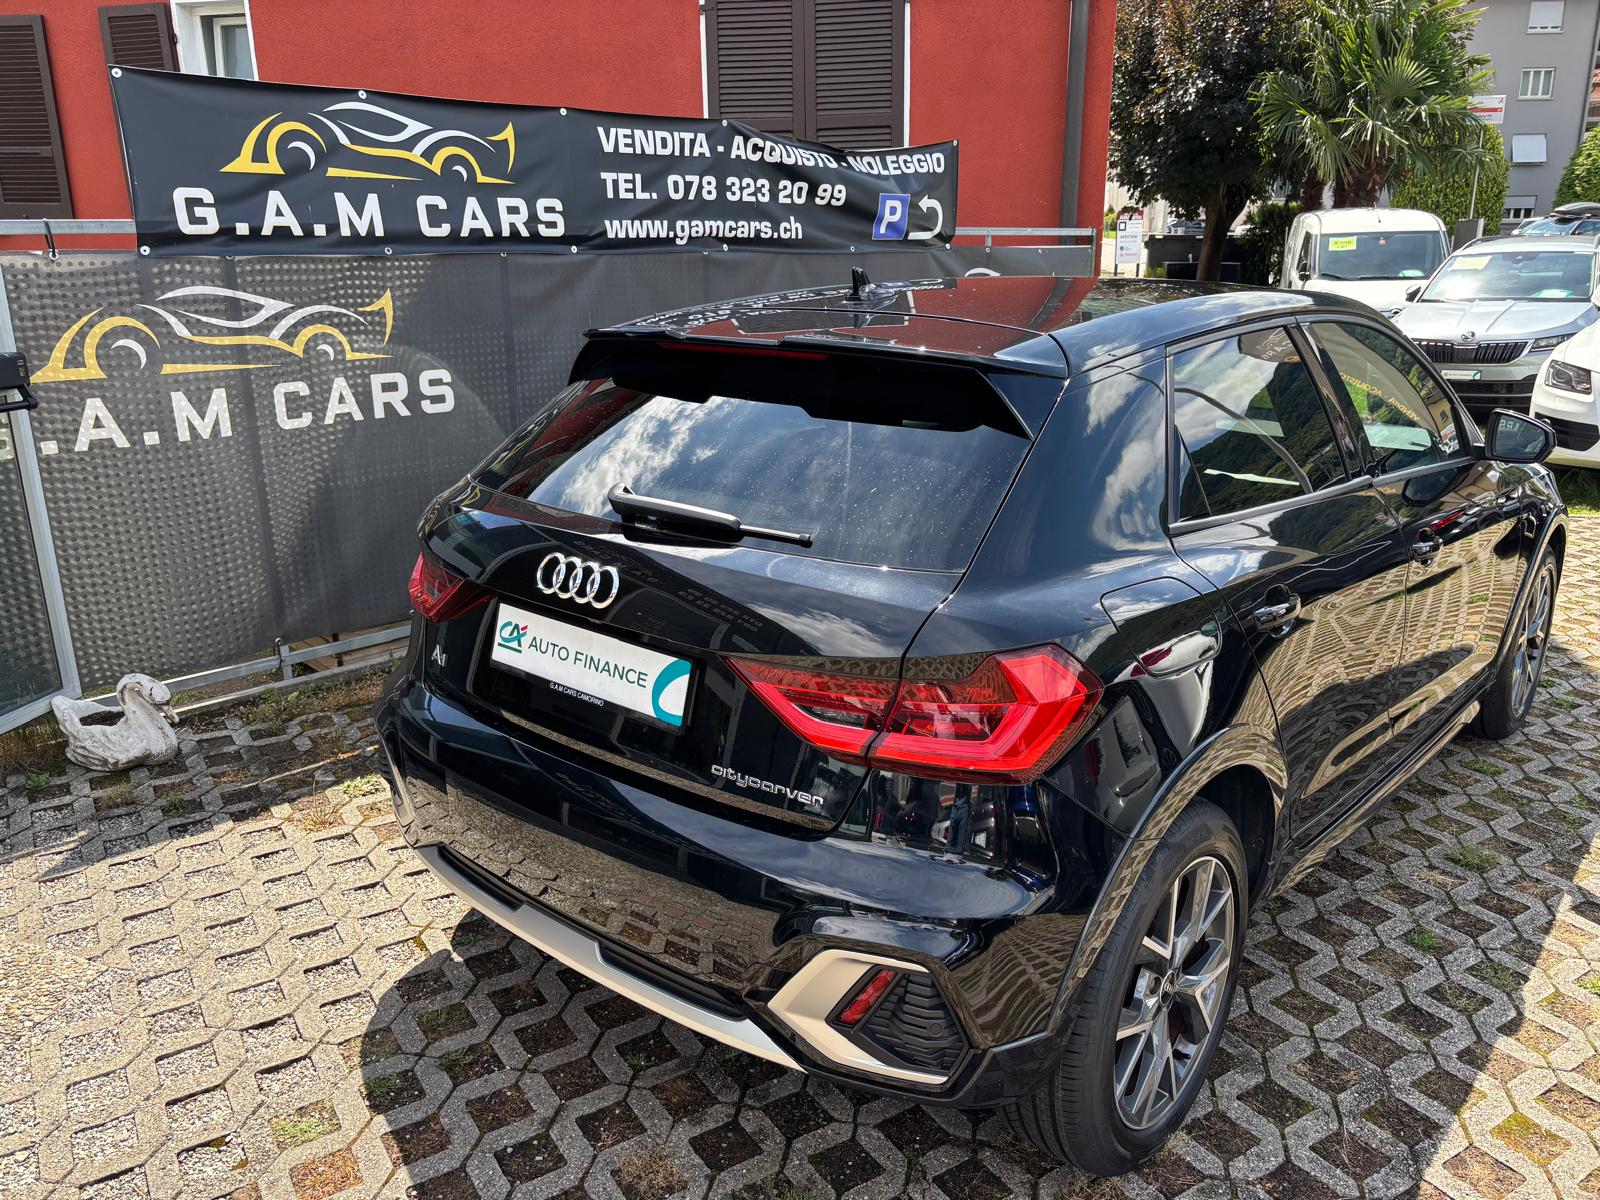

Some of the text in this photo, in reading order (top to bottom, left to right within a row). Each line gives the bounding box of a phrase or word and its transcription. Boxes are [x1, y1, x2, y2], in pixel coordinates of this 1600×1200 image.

[597, 127, 711, 157] VENDITA
[730, 135, 838, 169] ACQUISTO
[846, 153, 945, 175] NOLEGGIO
[600, 172, 847, 206] TEL. 078 323 20 99
[173, 186, 566, 238] G.A.M CARS
[604, 216, 803, 246] www.gamcars.ch
[880, 200, 902, 234] P
[273, 368, 456, 429] CARS
[528, 636, 649, 688] AUTO FINANCE
[563, 687, 577, 697] CARS
[577, 692, 605, 707] CAMORINO
[710, 764, 824, 807] citycarver
